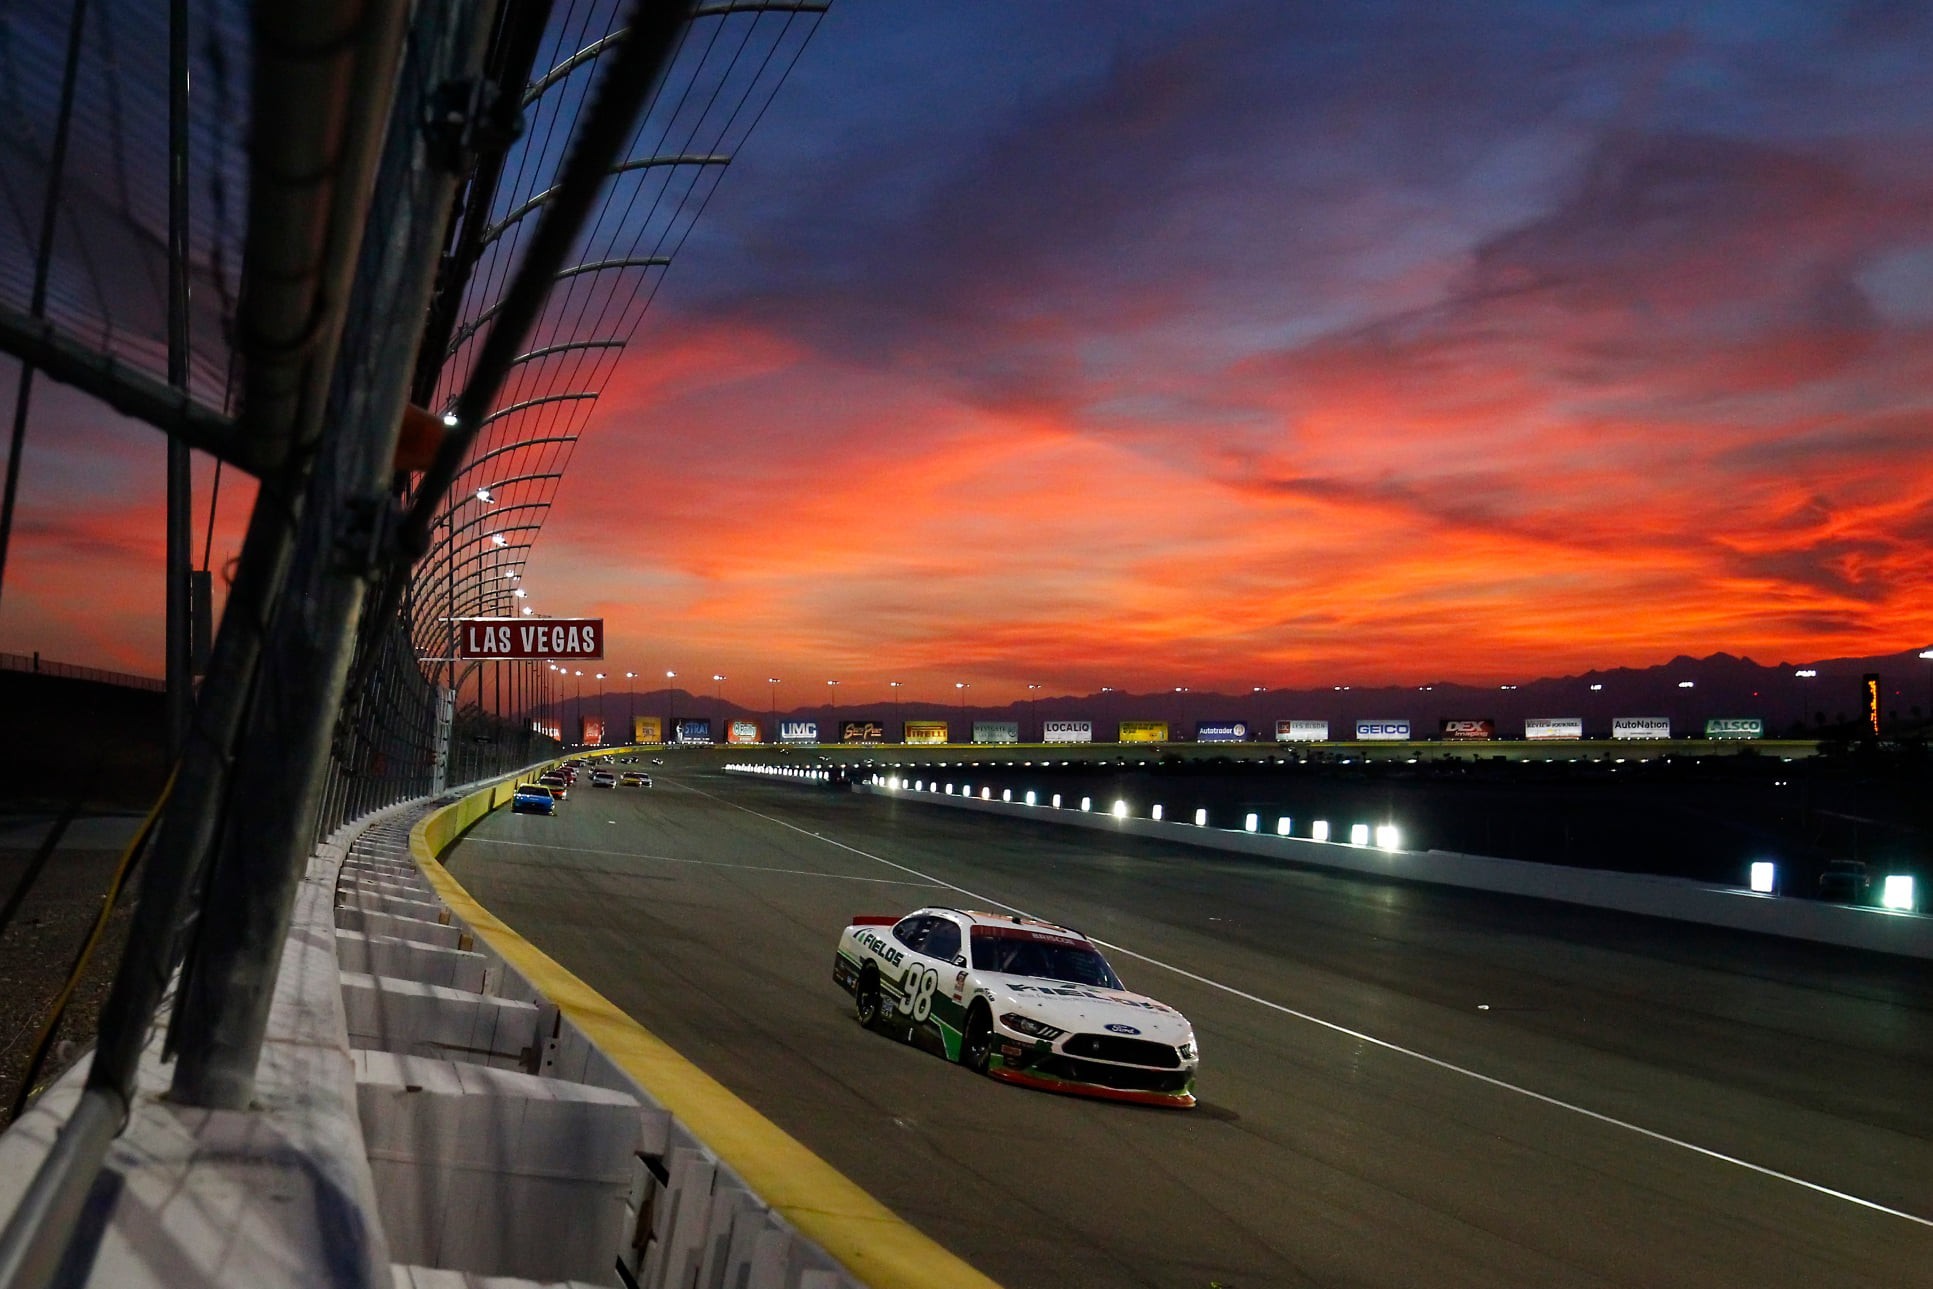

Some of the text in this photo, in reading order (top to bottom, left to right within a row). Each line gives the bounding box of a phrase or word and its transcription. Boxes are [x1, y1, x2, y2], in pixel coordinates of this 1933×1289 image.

[469, 626, 595, 653] LAS VEGAS
[1357, 724, 1409, 734] GEICO
[1446, 721, 1485, 731] DEX
[1614, 720, 1668, 729] AutoNation
[1199, 727, 1233, 735] Autotrader
[898, 962, 939, 1023] 98
[1111, 1024, 1134, 1035] Ford
